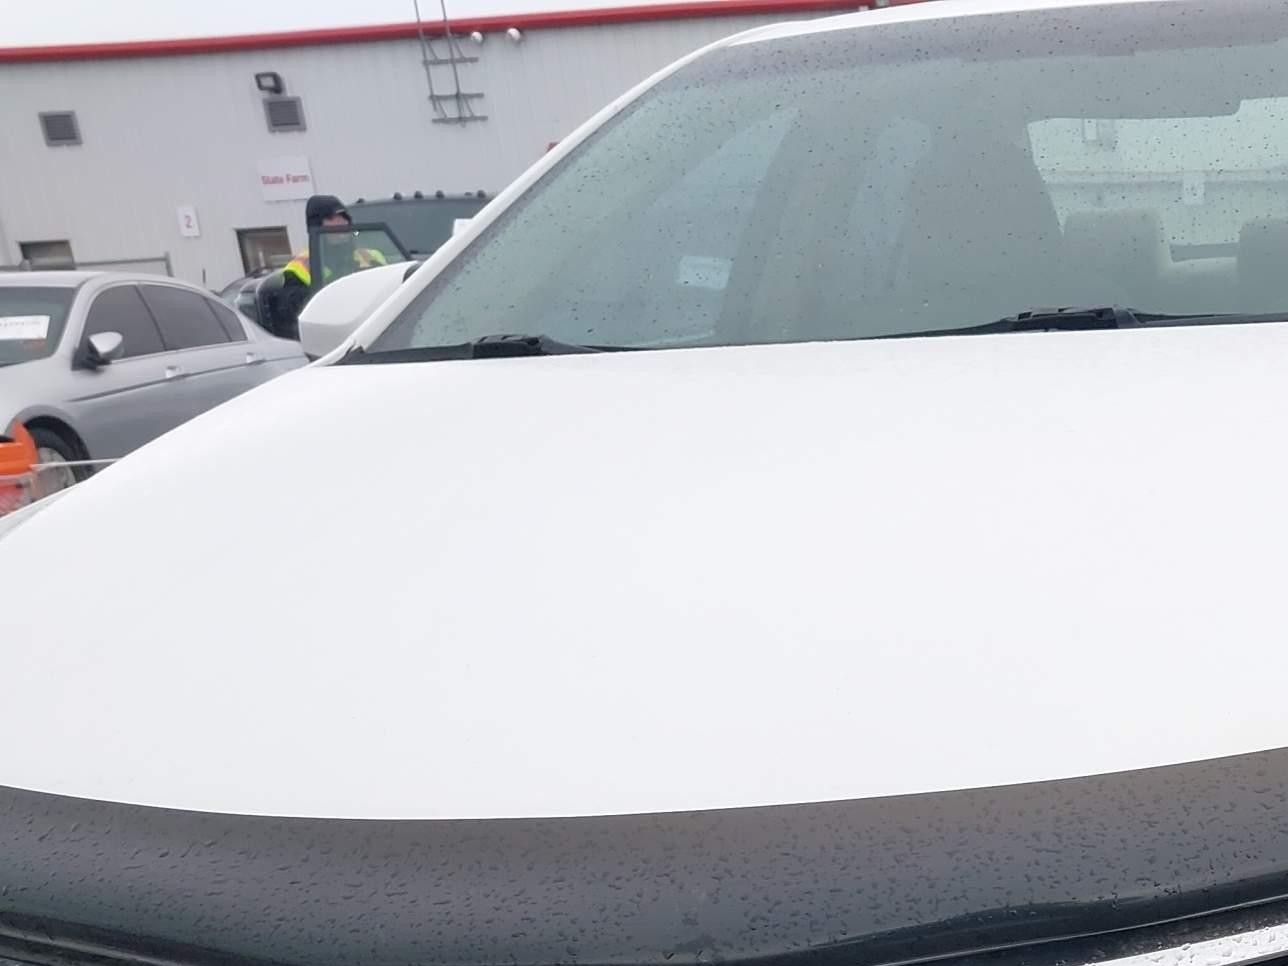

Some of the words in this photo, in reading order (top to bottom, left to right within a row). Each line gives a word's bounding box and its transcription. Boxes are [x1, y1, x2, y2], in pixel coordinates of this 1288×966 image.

[261, 174, 284, 185] State
[286, 173, 310, 184] Farm
[184, 215, 192, 229] 2
